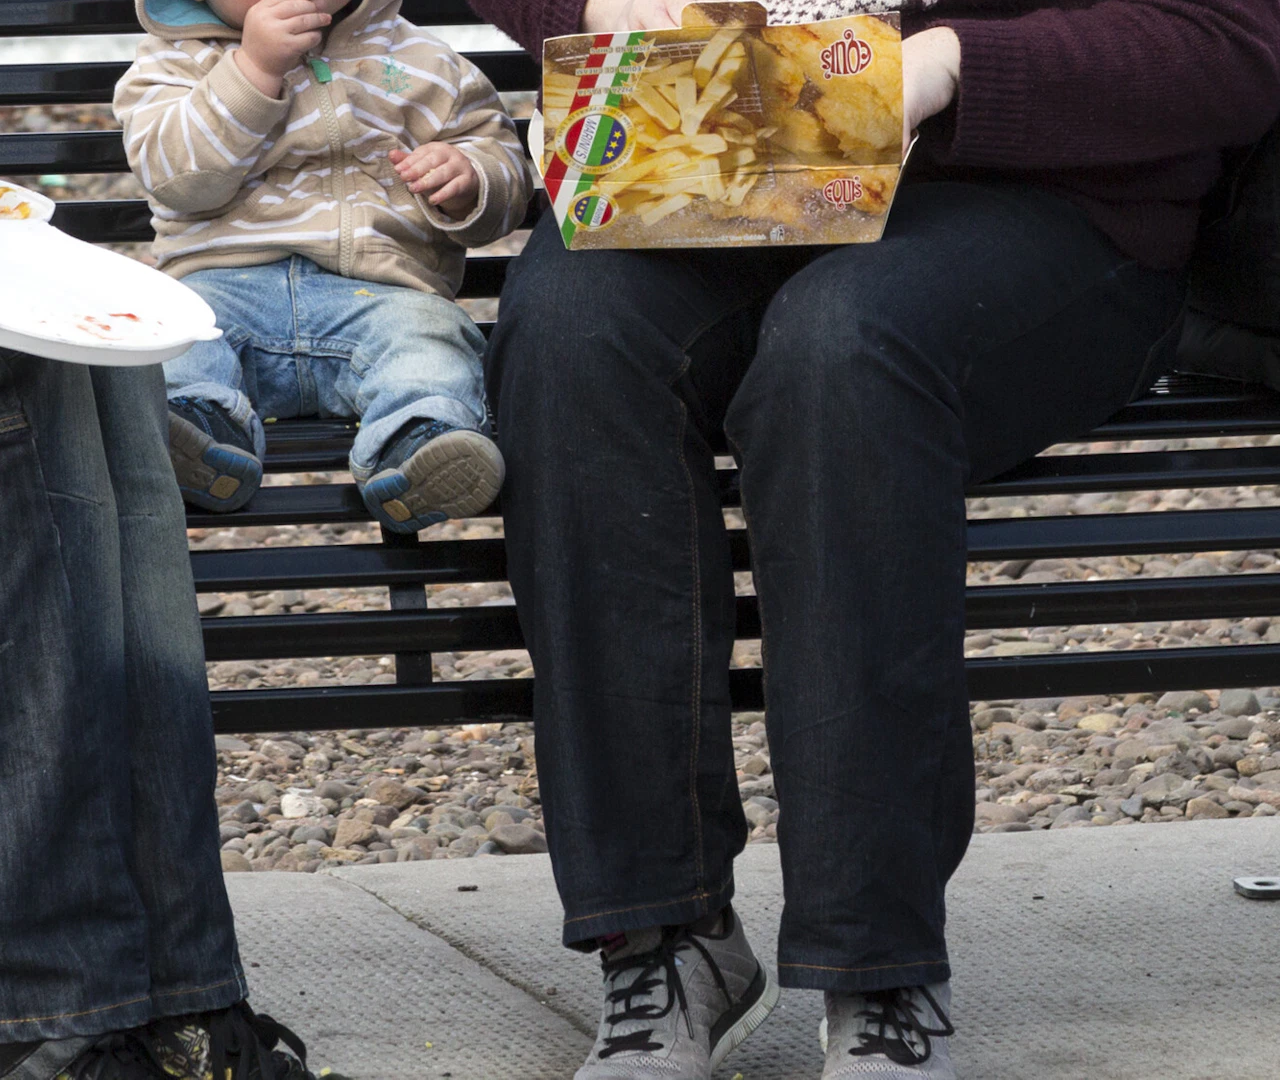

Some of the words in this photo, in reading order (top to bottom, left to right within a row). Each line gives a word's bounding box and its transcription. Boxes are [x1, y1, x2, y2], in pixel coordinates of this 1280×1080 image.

[821, 29, 872, 79] EQUIS
[576, 118, 597, 159] MARINI'S
[823, 176, 862, 210] EQUIS
